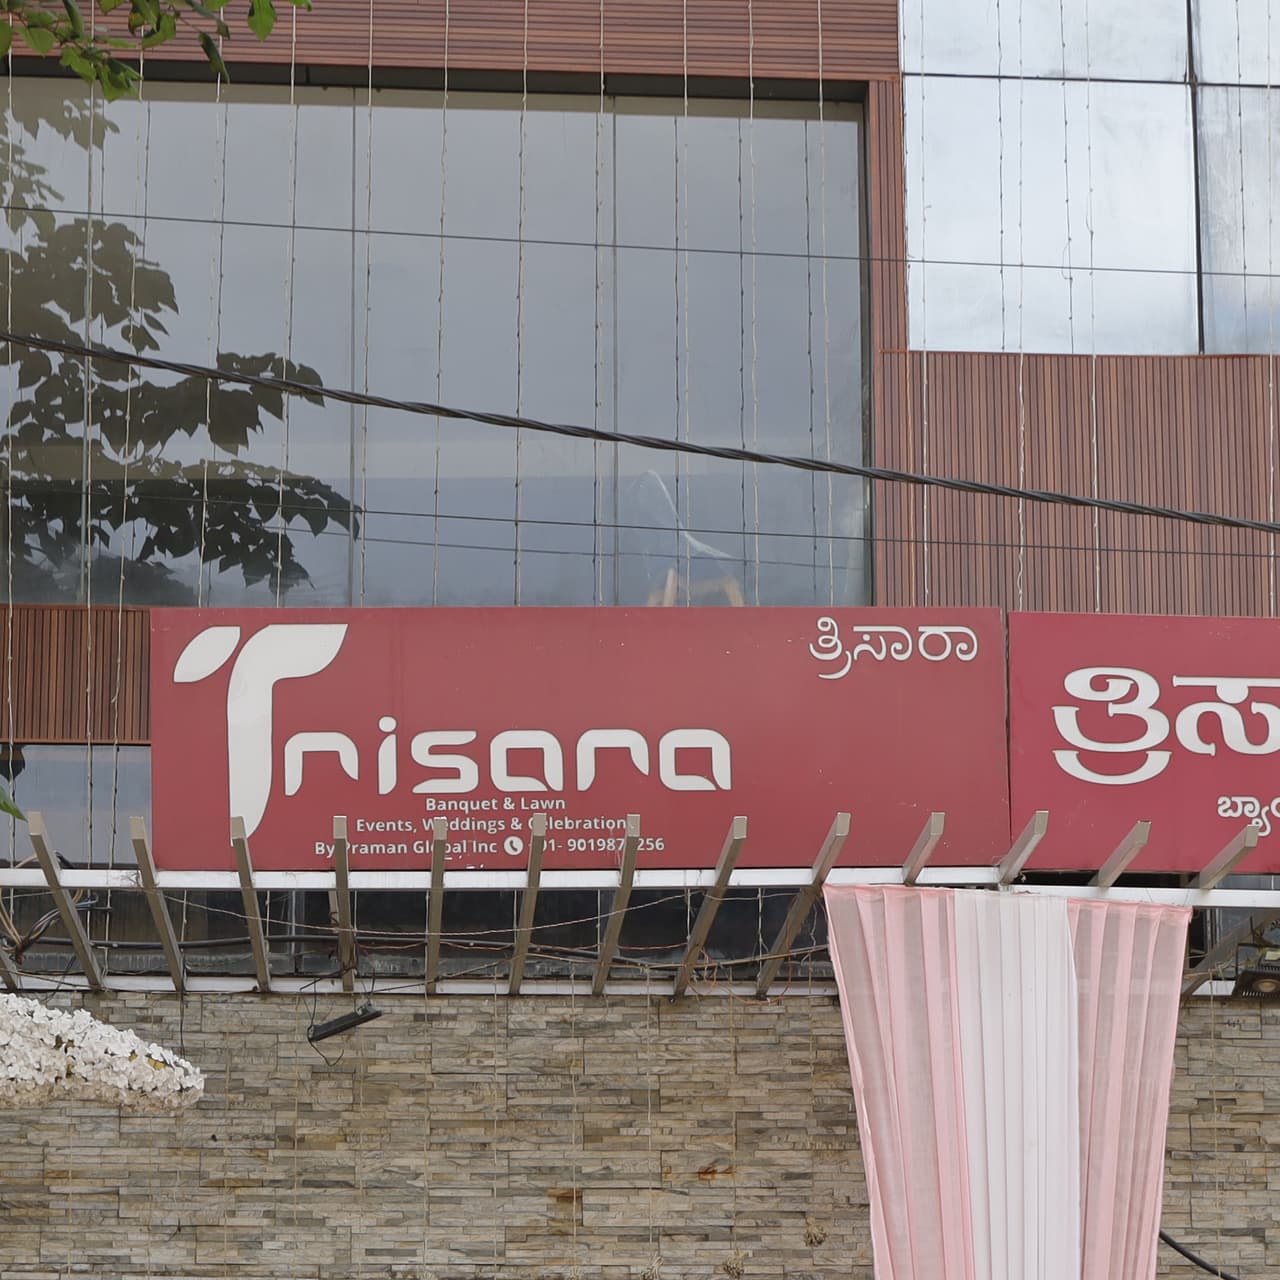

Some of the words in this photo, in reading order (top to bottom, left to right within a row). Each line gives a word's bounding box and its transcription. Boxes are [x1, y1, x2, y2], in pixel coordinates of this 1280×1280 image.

[809, 616, 978, 680] ತ್ರಿಸಾರಾ
[173, 623, 732, 846] Trisara
[426, 798, 498, 813] Banquet
[503, 798, 516, 810] &
[520, 797, 566, 810] Lawn
[356, 819, 417, 834] Events,
[422, 818, 505, 833] Wddings
[510, 819, 522, 830] &
[315, 841, 335, 858] By
[345, 840, 408, 855] raman
[473, 840, 496, 854] Inc
[568, 838, 664, 852] 901987256
